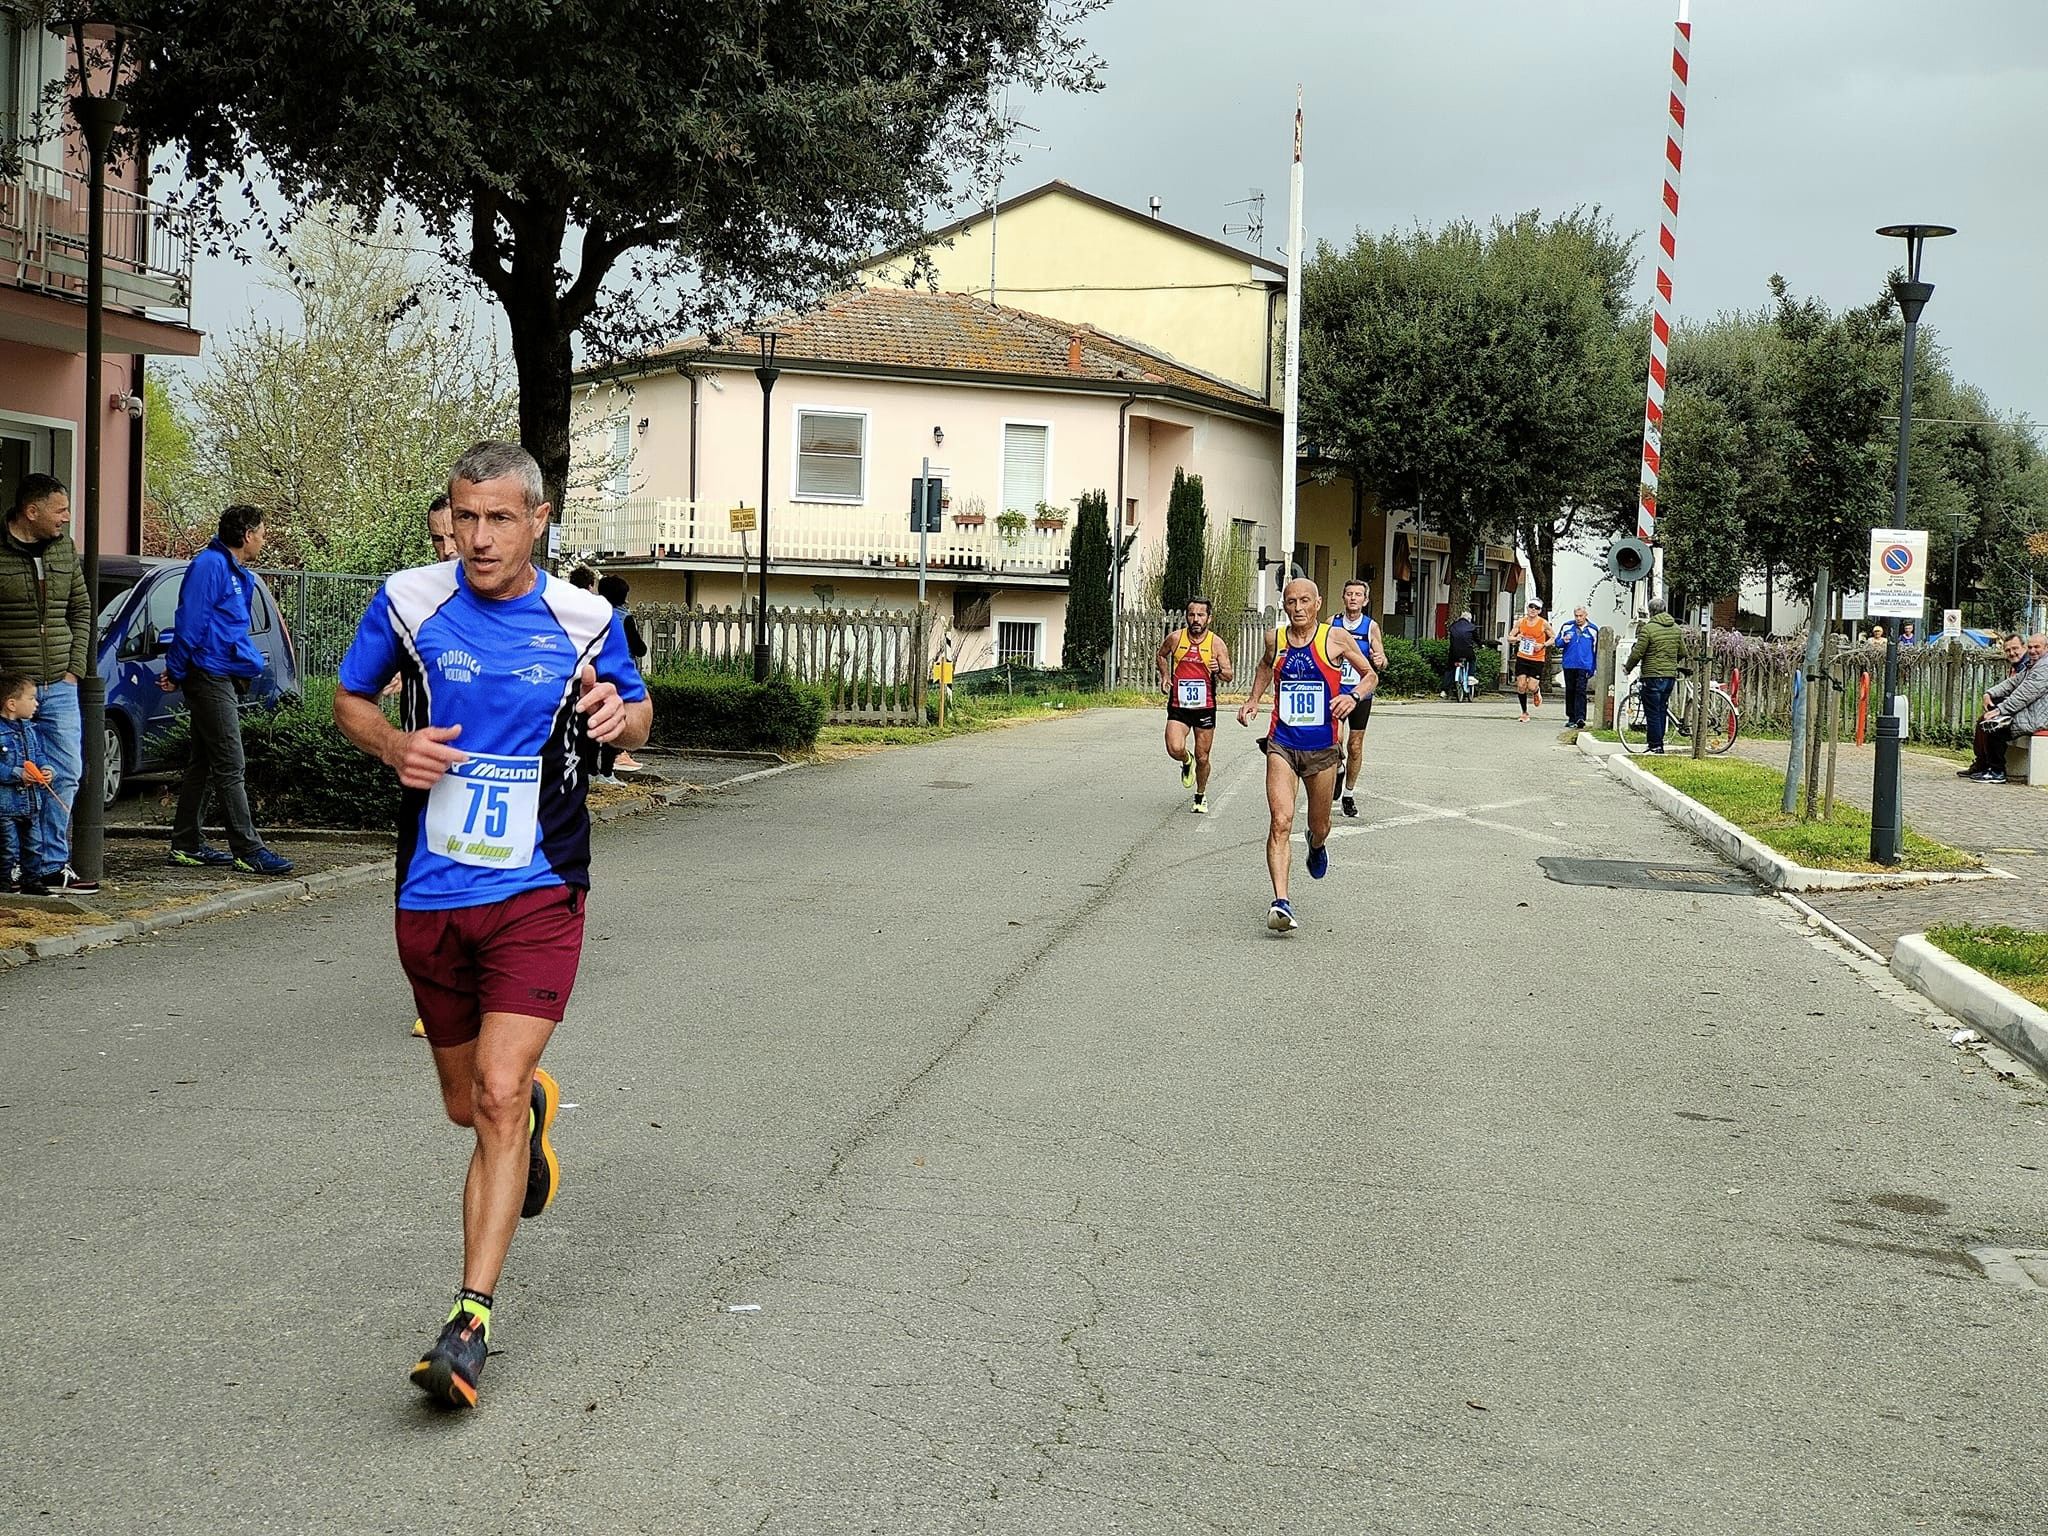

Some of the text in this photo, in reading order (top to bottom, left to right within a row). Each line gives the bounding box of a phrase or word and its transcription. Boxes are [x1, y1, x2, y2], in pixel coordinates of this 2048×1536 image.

[1413, 536, 1447, 551] TACCHERIA
[437, 649, 481, 676] PODISTICA
[1186, 687, 1199, 701] 33
[1289, 693, 1315, 714] 189
[462, 782, 510, 838] 75
